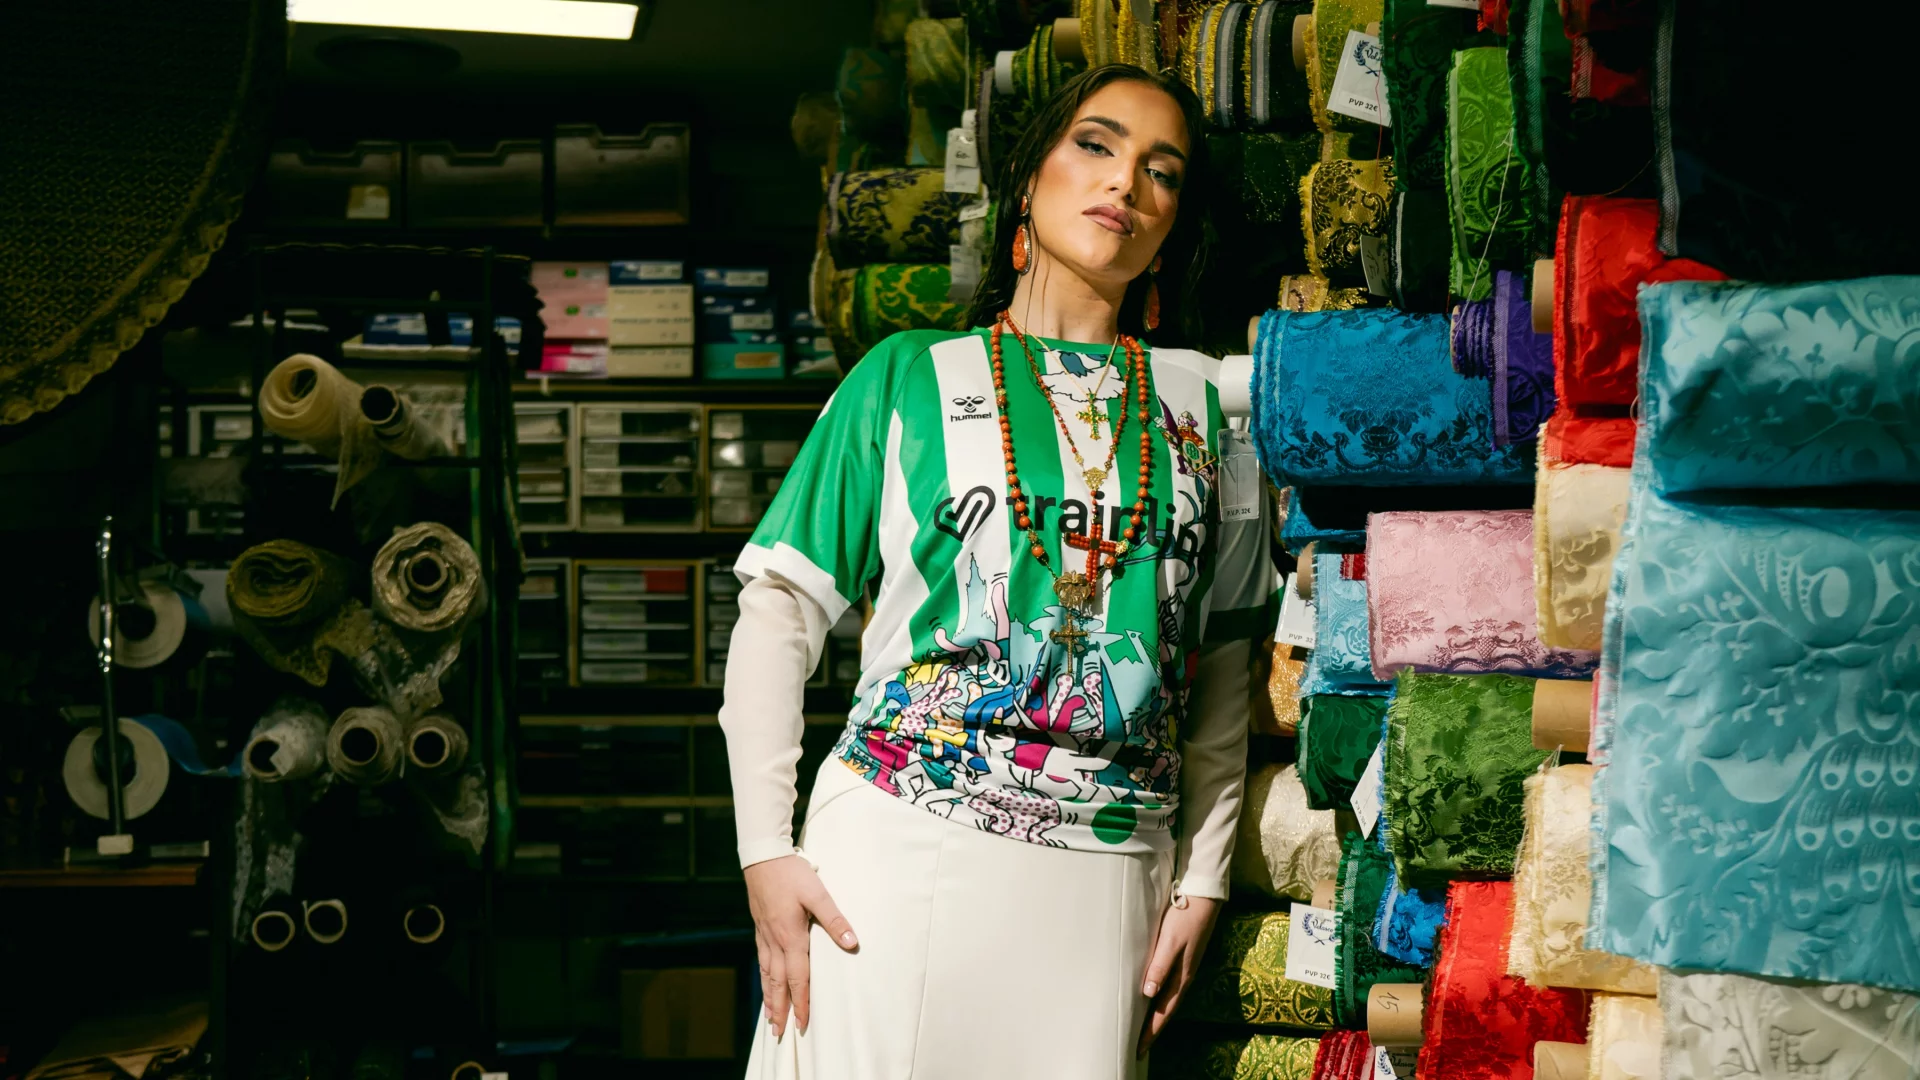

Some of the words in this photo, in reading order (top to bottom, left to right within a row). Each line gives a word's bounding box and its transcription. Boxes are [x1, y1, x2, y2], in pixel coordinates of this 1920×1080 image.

[1348, 97, 1364, 107] PVP
[1365, 102, 1379, 112] 32€
[950, 412, 992, 423] hummel
[1288, 633, 1303, 641] PVP
[1304, 969, 1318, 978] PVP
[1319, 973, 1332, 981] 32€
